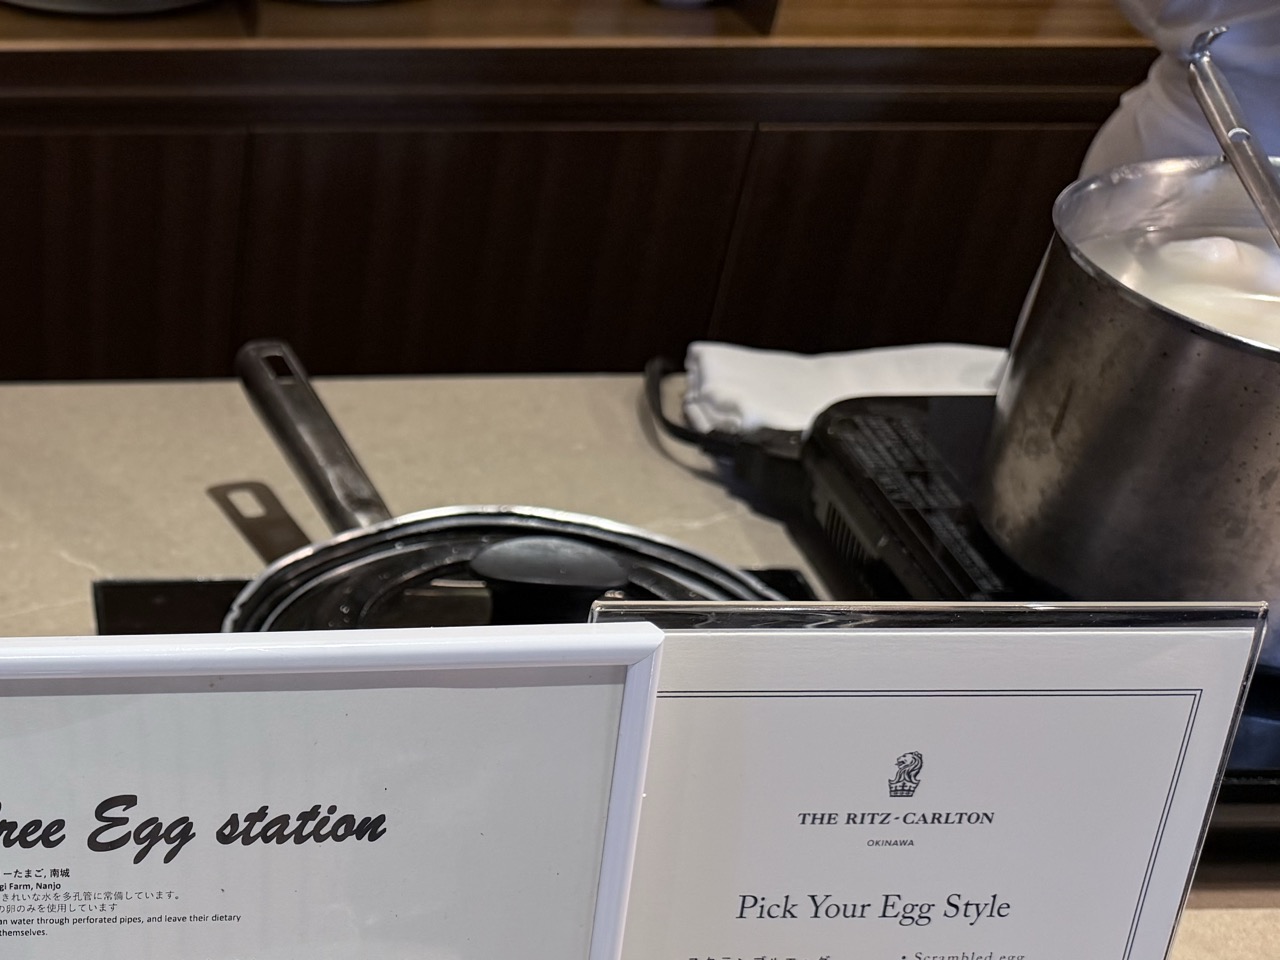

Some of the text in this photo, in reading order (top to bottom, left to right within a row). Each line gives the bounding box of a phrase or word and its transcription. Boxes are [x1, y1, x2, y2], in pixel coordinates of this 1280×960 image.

[798, 812, 994, 824] THE RITZ-CARLTON
[87, 795, 196, 864] Egg
[216, 805, 386, 846] station
[9, 883, 33, 891] Farm,
[36, 882, 61, 891] Nanjo
[736, 894, 1010, 926] Pick Your Egg Style
